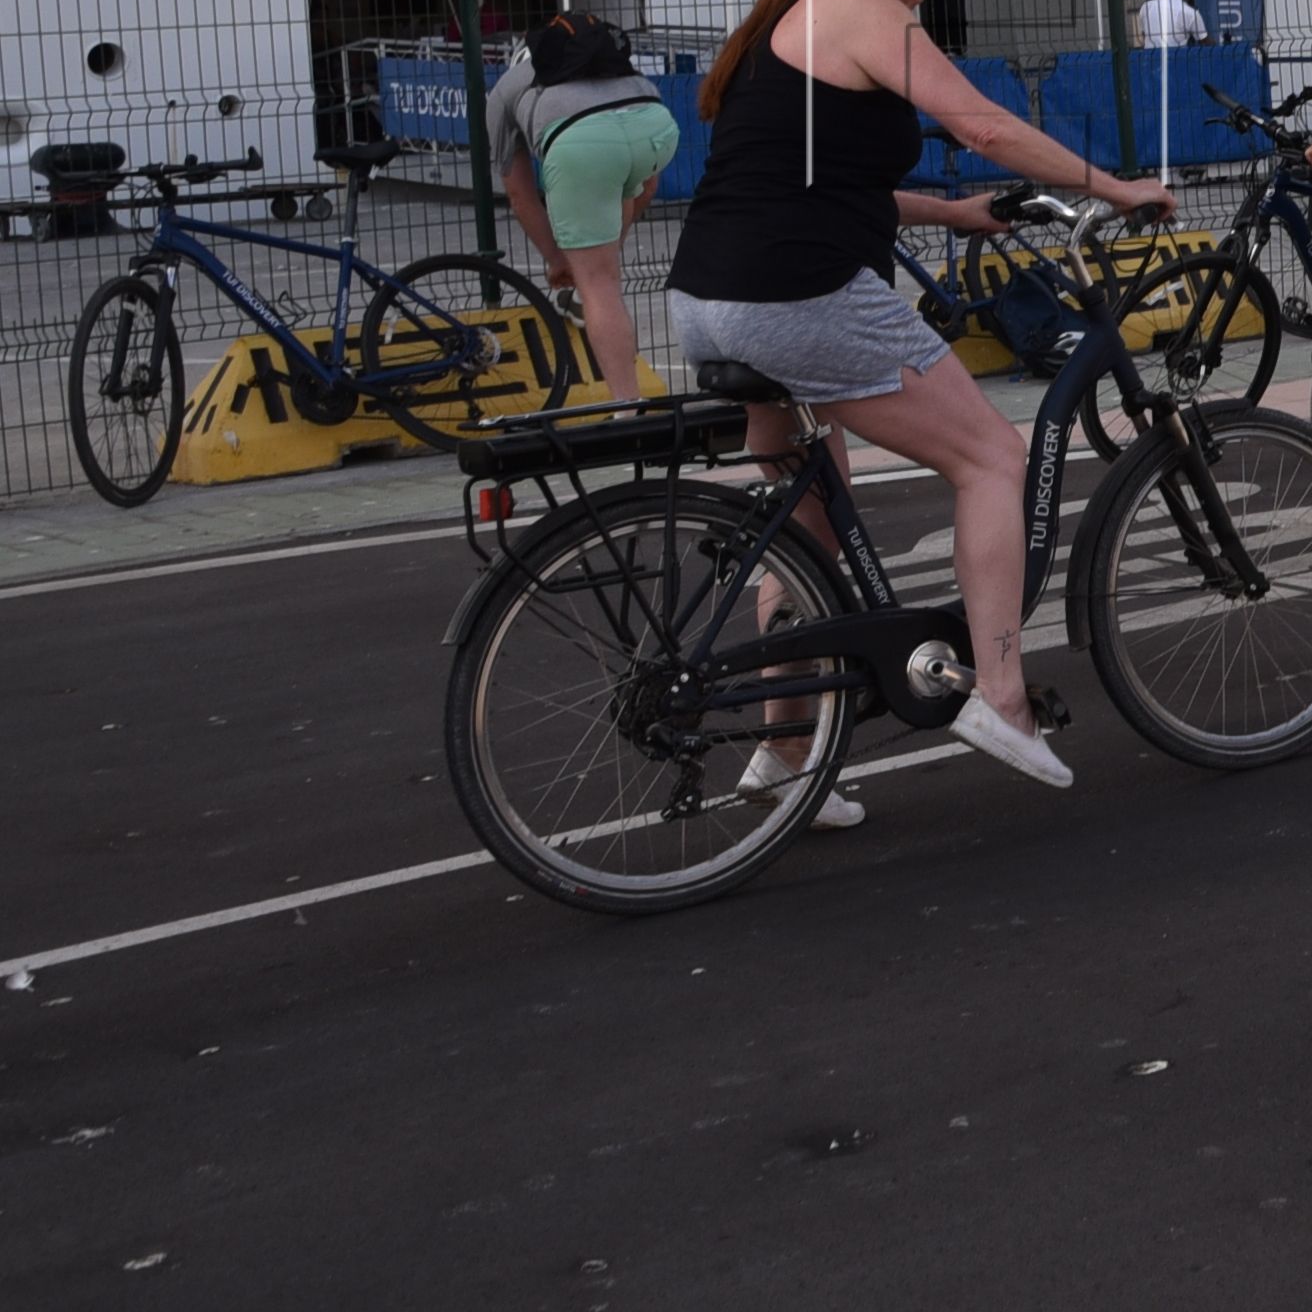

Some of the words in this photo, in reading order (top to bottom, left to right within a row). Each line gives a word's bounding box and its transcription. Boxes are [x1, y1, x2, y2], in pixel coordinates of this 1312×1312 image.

[390, 83, 414, 115] TUI
[417, 85, 468, 119] DISCOV
[223, 270, 240, 287] TUI
[237, 285, 283, 328] DISCOVERY
[1035, 420, 1061, 517] DISCOVERY
[1030, 521, 1048, 551] TUI
[848, 525, 864, 547] TUI
[856, 546, 891, 606] DISCOVERY
